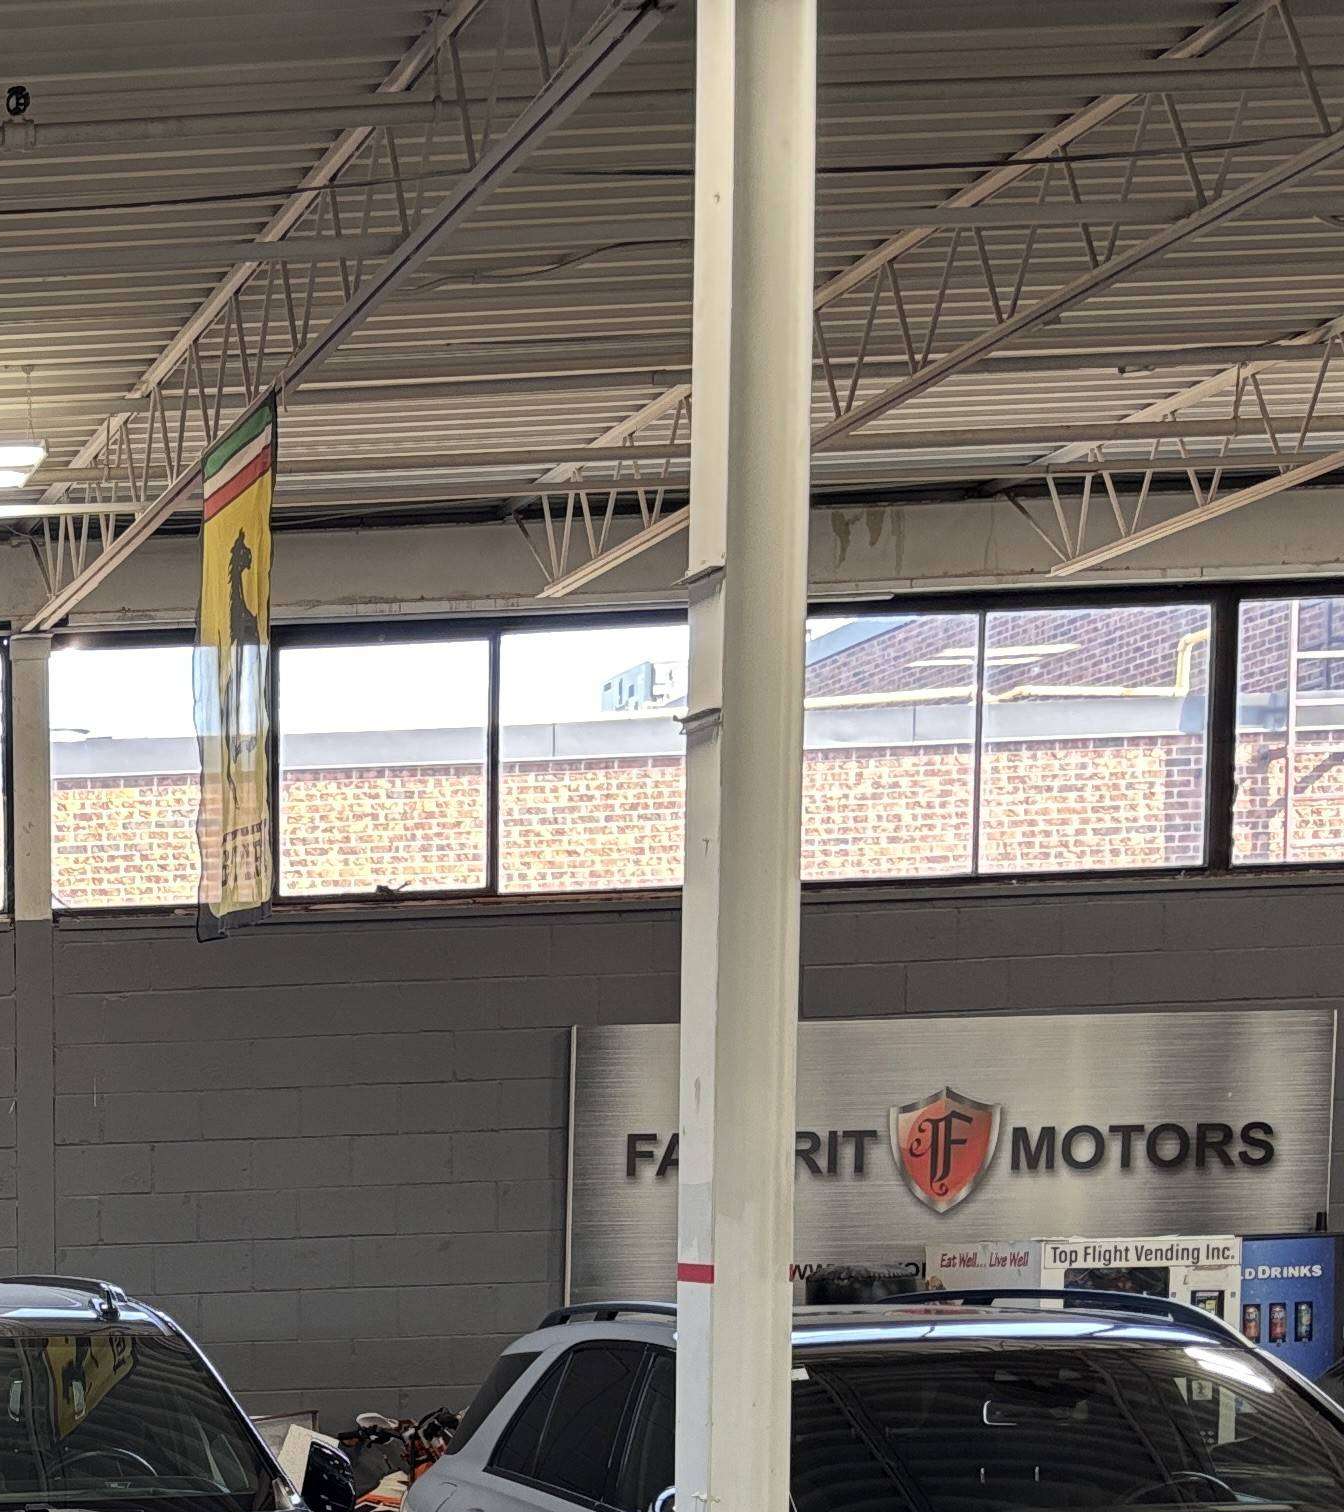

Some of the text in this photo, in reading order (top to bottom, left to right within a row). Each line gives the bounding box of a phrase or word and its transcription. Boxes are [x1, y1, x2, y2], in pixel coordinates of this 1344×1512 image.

[1011, 1121, 1275, 1171] MOTORS
[940, 1252, 957, 1268] Eat
[989, 1252, 1008, 1268] Live
[1010, 1251, 1030, 1268] Well
[1051, 1243, 1235, 1266] Top Flight Vending Inc.
